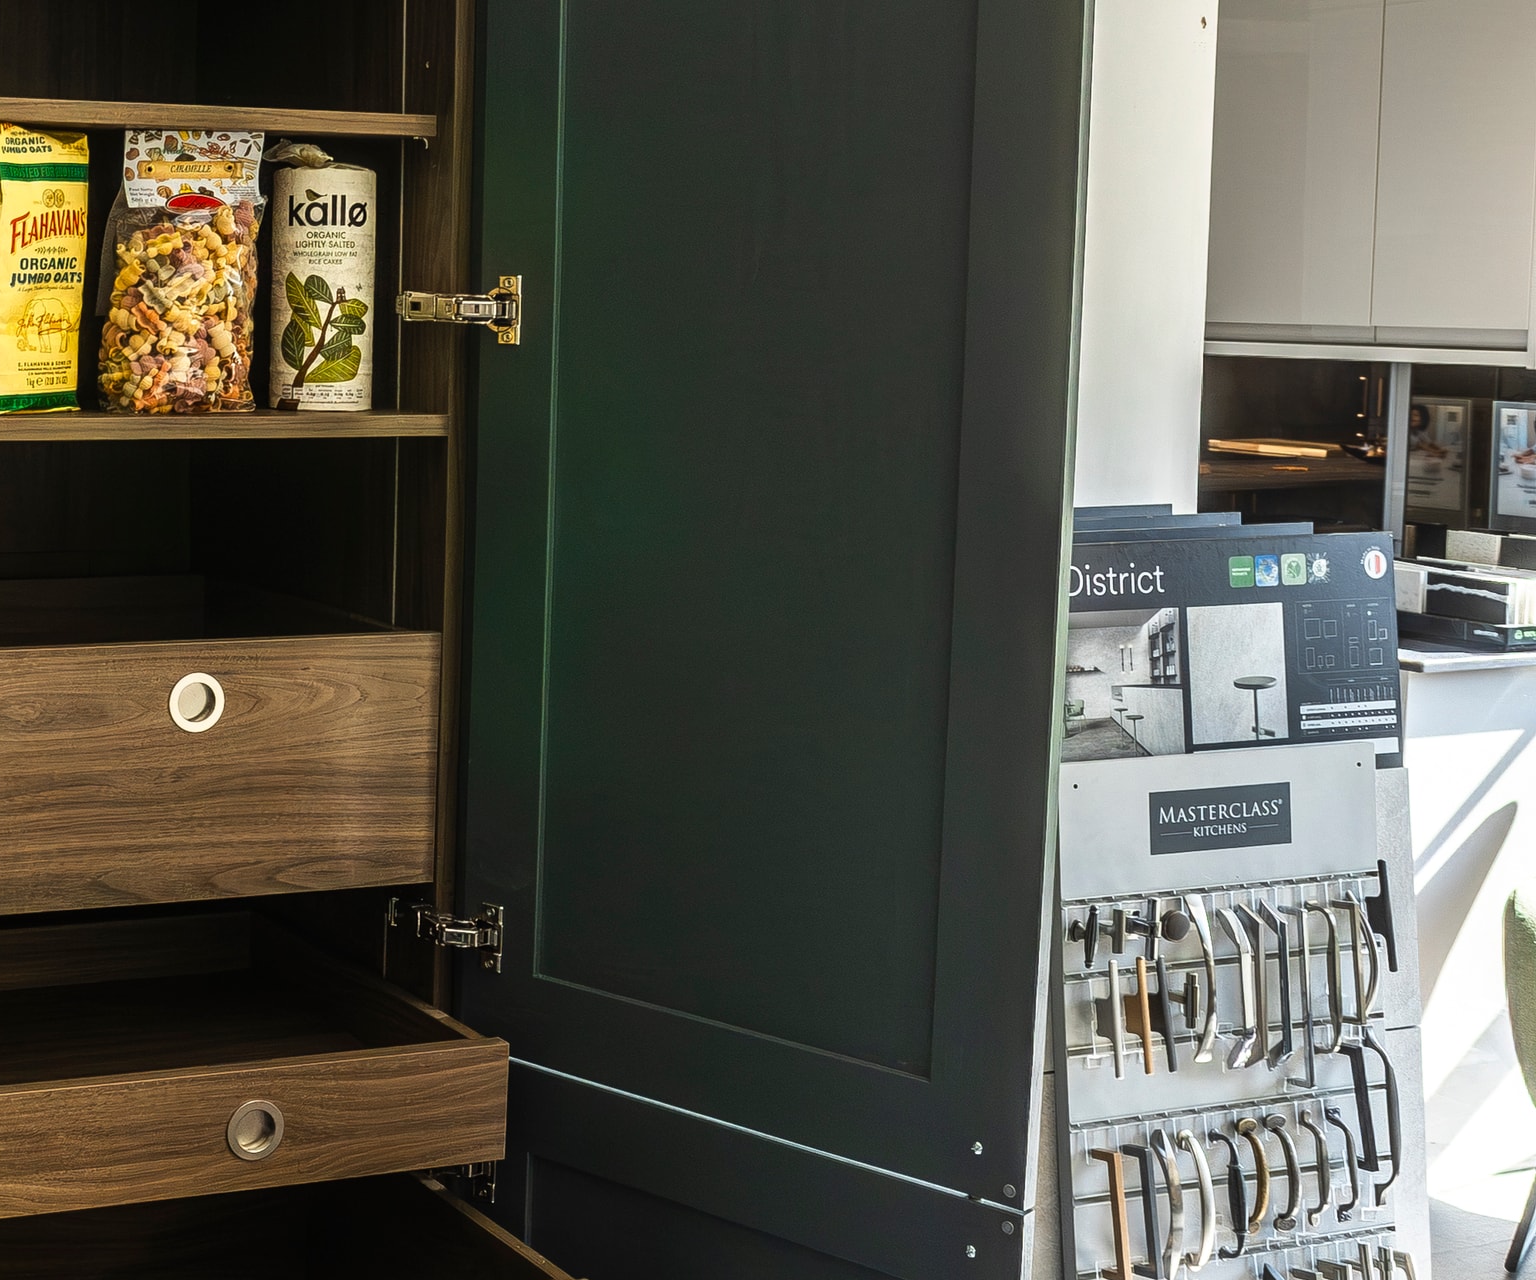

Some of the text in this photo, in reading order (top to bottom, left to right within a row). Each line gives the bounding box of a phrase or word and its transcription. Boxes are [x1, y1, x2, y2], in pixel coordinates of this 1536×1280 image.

[5, 136, 46, 146] ORGANIC
[1, 145, 28, 154] JUMBO
[29, 145, 53, 153] OATS
[170, 164, 213, 173] CARAMELLE
[289, 195, 367, 227] kallø
[10, 207, 86, 255] FLAHAVAN'S
[306, 231, 346, 239] ORGANIC
[296, 240, 326, 248] LIGHTLY
[20, 256, 77, 270] ORGANIC
[10, 271, 82, 287] JUMBO OATS
[1069, 562, 1165, 597] District
[1193, 822, 1247, 838] KITCHENS
